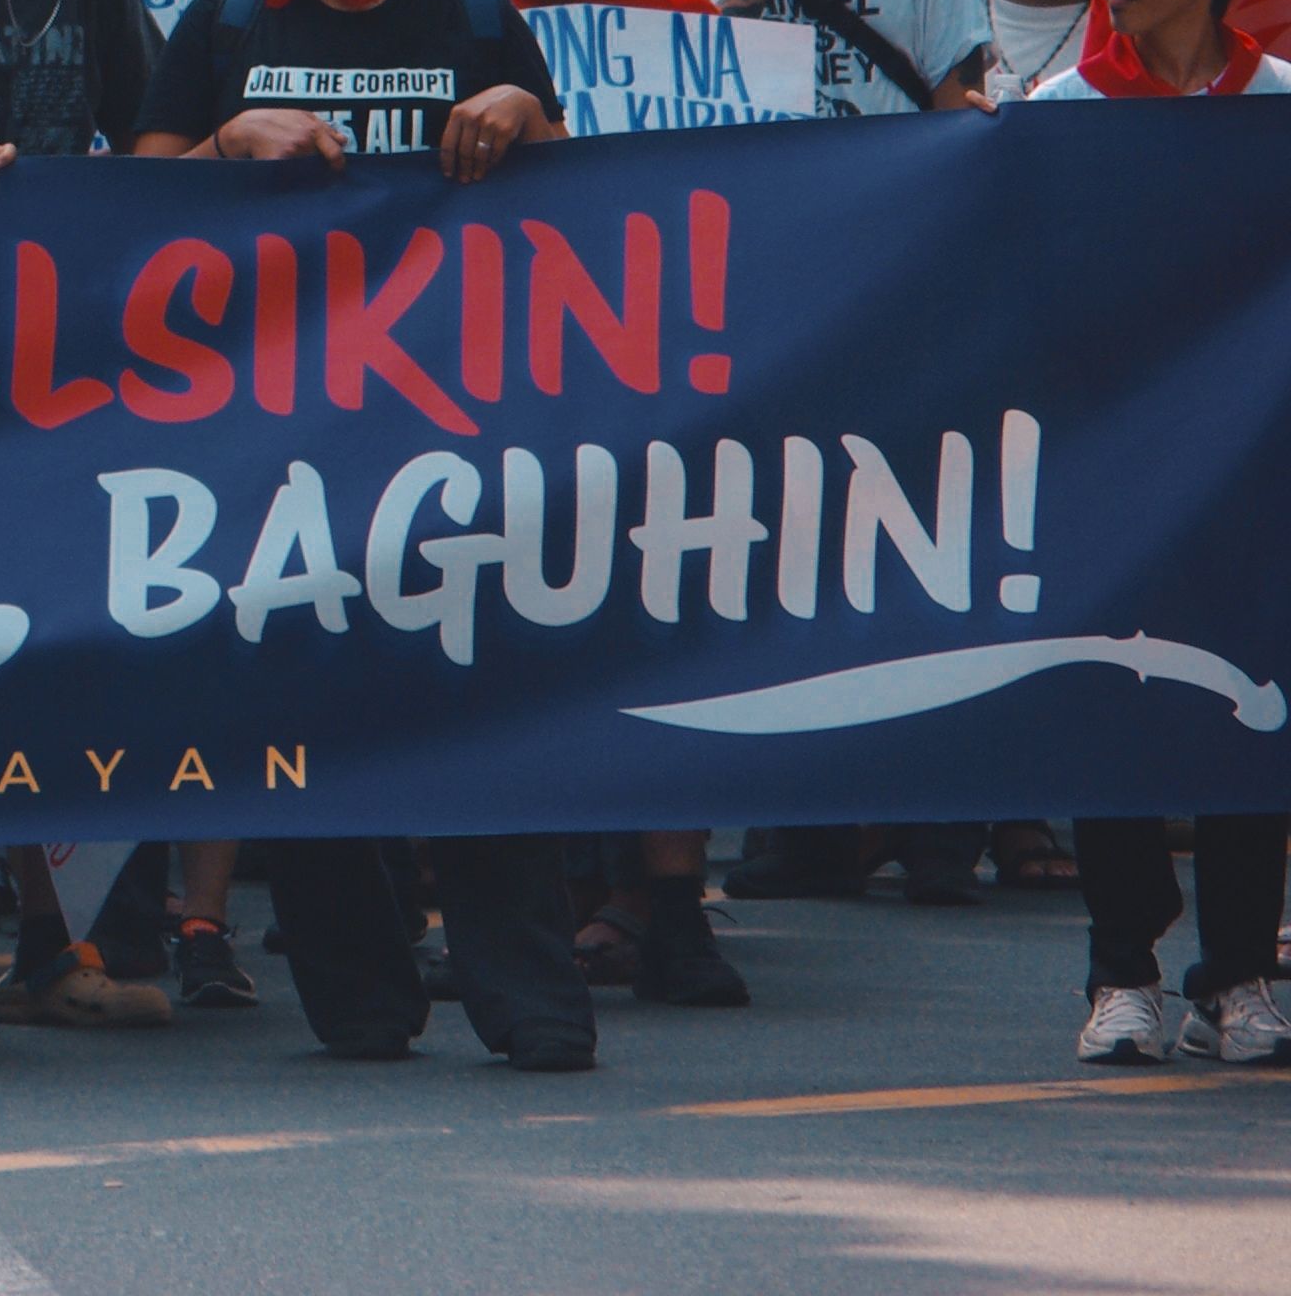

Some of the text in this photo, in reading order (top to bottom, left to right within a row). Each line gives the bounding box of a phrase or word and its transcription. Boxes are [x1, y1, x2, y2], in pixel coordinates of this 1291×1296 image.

[249, 70, 451, 95] JAIL THE CORRUPT
[671, 11, 750, 104] NA
[365, 109, 431, 154] ALL
[95, 408, 1041, 664] BAGUHIN!
